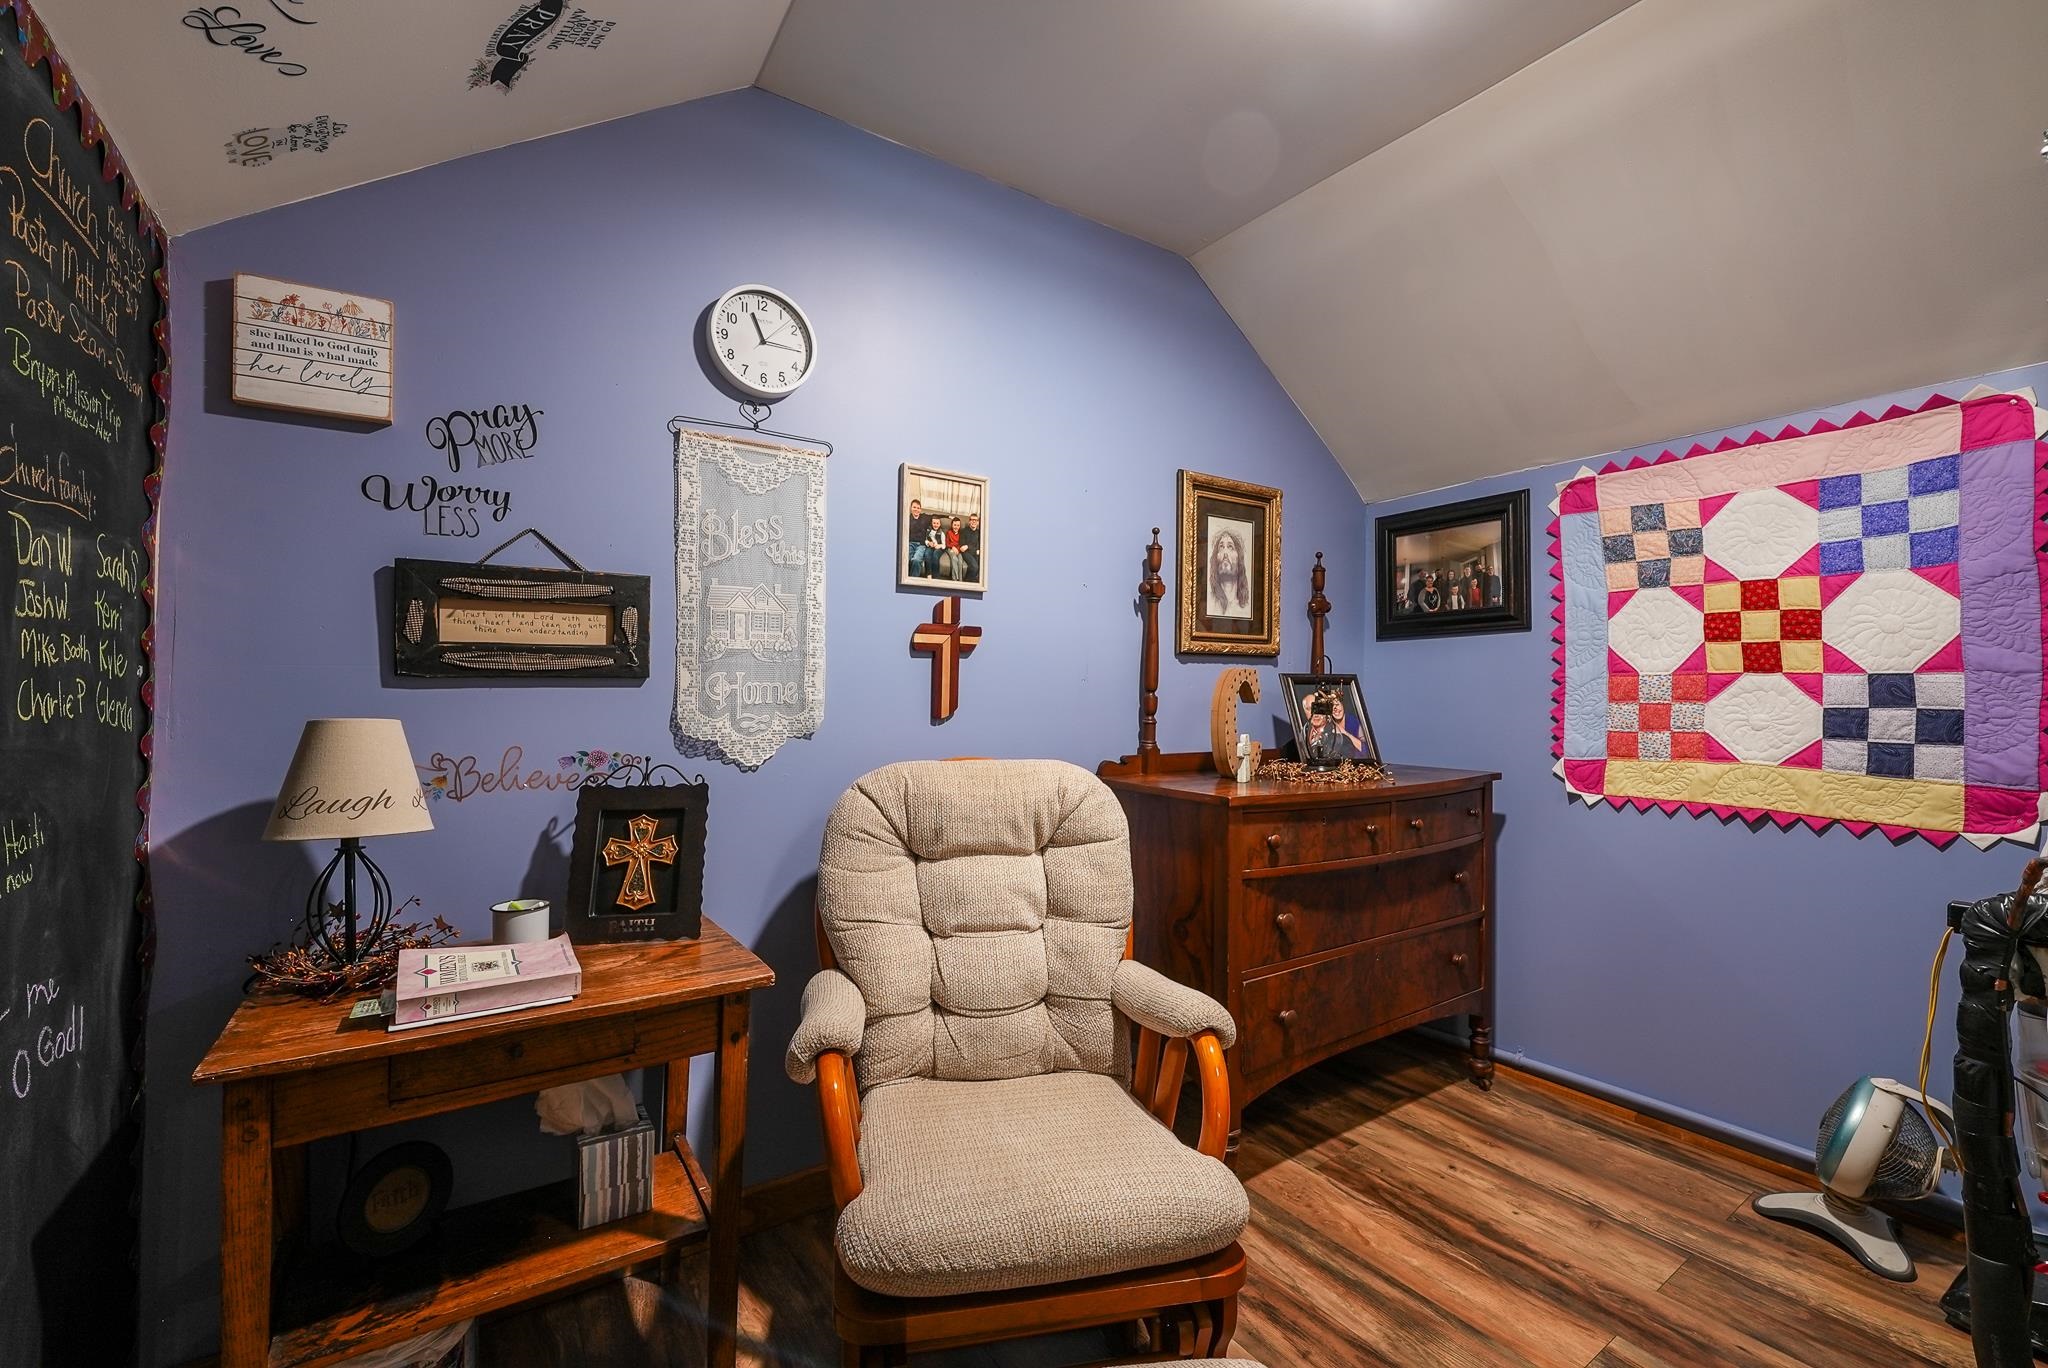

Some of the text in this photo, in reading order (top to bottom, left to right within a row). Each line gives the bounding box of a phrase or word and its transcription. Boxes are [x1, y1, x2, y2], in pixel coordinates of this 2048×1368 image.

[182, 6, 307, 76] Love
[502, 7, 556, 50] PRAY
[547, 8, 586, 51] ANYTHING
[564, 16, 591, 45] ABOUT
[575, 18, 604, 48] WORRY
[587, 21, 616, 50] DO NOT
[237, 128, 273, 166] LOVE
[5, 259, 65, 334] Pastor
[741, 301, 748, 313] 11
[757, 299, 768, 312] 12
[726, 312, 738, 325] 10
[779, 309, 783, 321] 1
[790, 325, 798, 336] 2
[250, 328, 379, 359] she talked to God daily
[720, 328, 729, 340] 9
[251, 340, 379, 367] and that is what made
[727, 348, 735, 360] 8
[742, 364, 749, 375] 7
[791, 361, 799, 372] 4
[240, 352, 388, 394] her lovely
[760, 372, 768, 384] 6
[778, 371, 786, 383] 5
[101, 388, 122, 443] Trip
[426, 403, 544, 472] Pray
[474, 429, 534, 468] MORE
[361, 474, 511, 522] Worry
[424, 504, 480, 537] LESS
[701, 508, 784, 567] Bless
[8, 510, 52, 571] Dan
[766, 540, 806, 566] this
[96, 532, 130, 592] Sarah
[15, 578, 53, 619] Josh
[95, 590, 123, 632] Kerri
[462, 610, 486, 618] Trust
[511, 611, 525, 619] the
[533, 612, 554, 621] Lord
[562, 614, 580, 622] with
[452, 617, 477, 626] thine
[486, 618, 510, 627] heart
[589, 622, 607, 630] unto
[474, 626, 497, 634] thine
[530, 628, 589, 638] understanding
[21, 627, 91, 668] Mike Booth
[98, 640, 128, 679] Kyle
[17, 679, 74, 724] Charlie
[96, 680, 133, 732] Glenda
[705, 671, 799, 719] Home
[430, 745, 581, 802] Believe
[278, 785, 396, 820] Laugh
